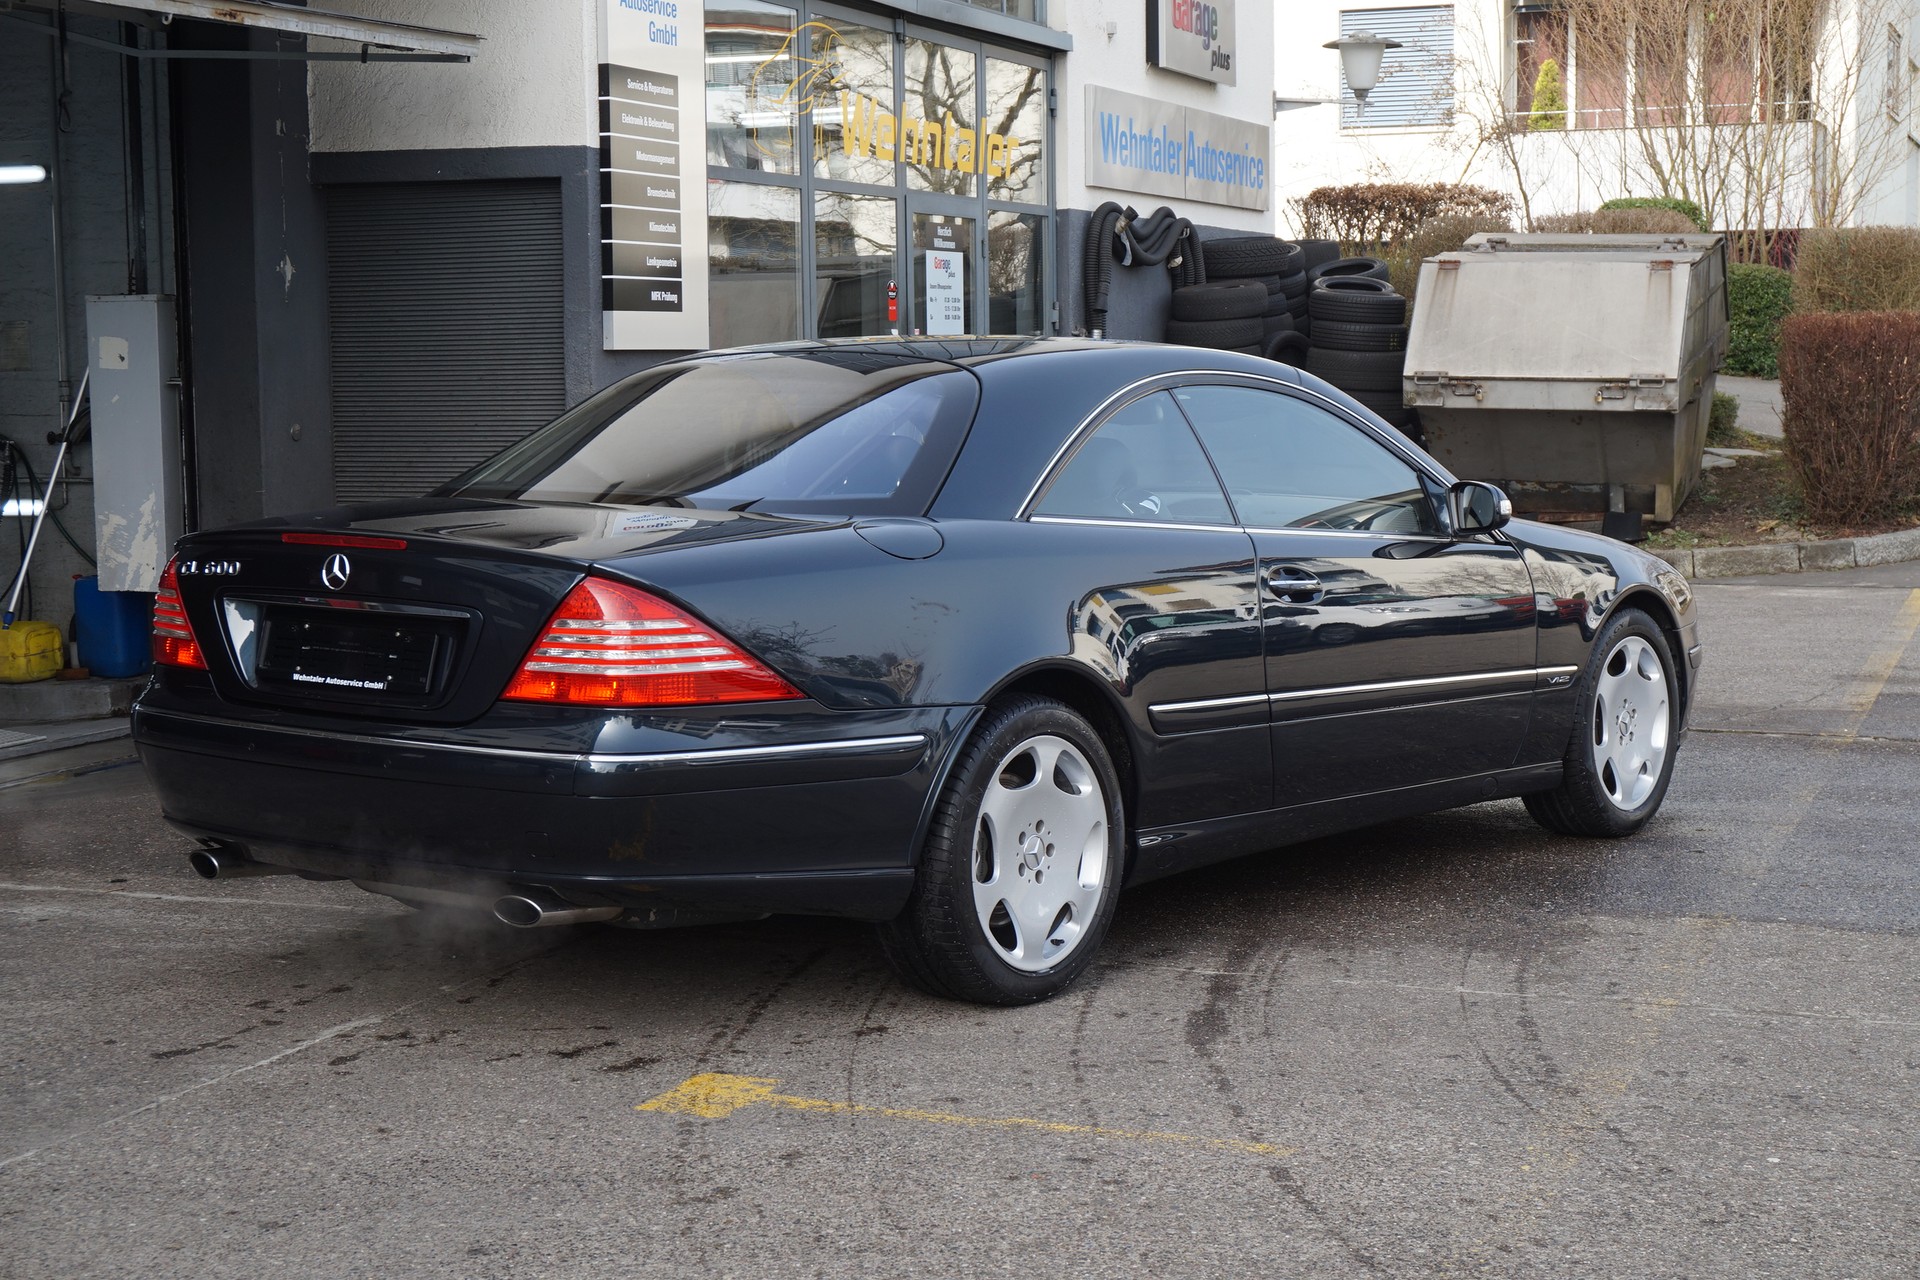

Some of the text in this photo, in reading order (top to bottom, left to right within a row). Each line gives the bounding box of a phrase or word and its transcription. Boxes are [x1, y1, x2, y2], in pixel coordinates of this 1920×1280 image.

[649, 21, 677, 46] GmbH
[1172, 0, 1218, 51] Garage
[1210, 44, 1231, 72] plus
[627, 78, 643, 91] Service
[841, 90, 1021, 180] Wehntaler
[1099, 111, 1264, 190] Wehntaler Autoservice
[180, 560, 242, 576] CL 600
[292, 673, 384, 690] Wehntaler Autoservice GmbH
[1547, 676, 1570, 684] V12
